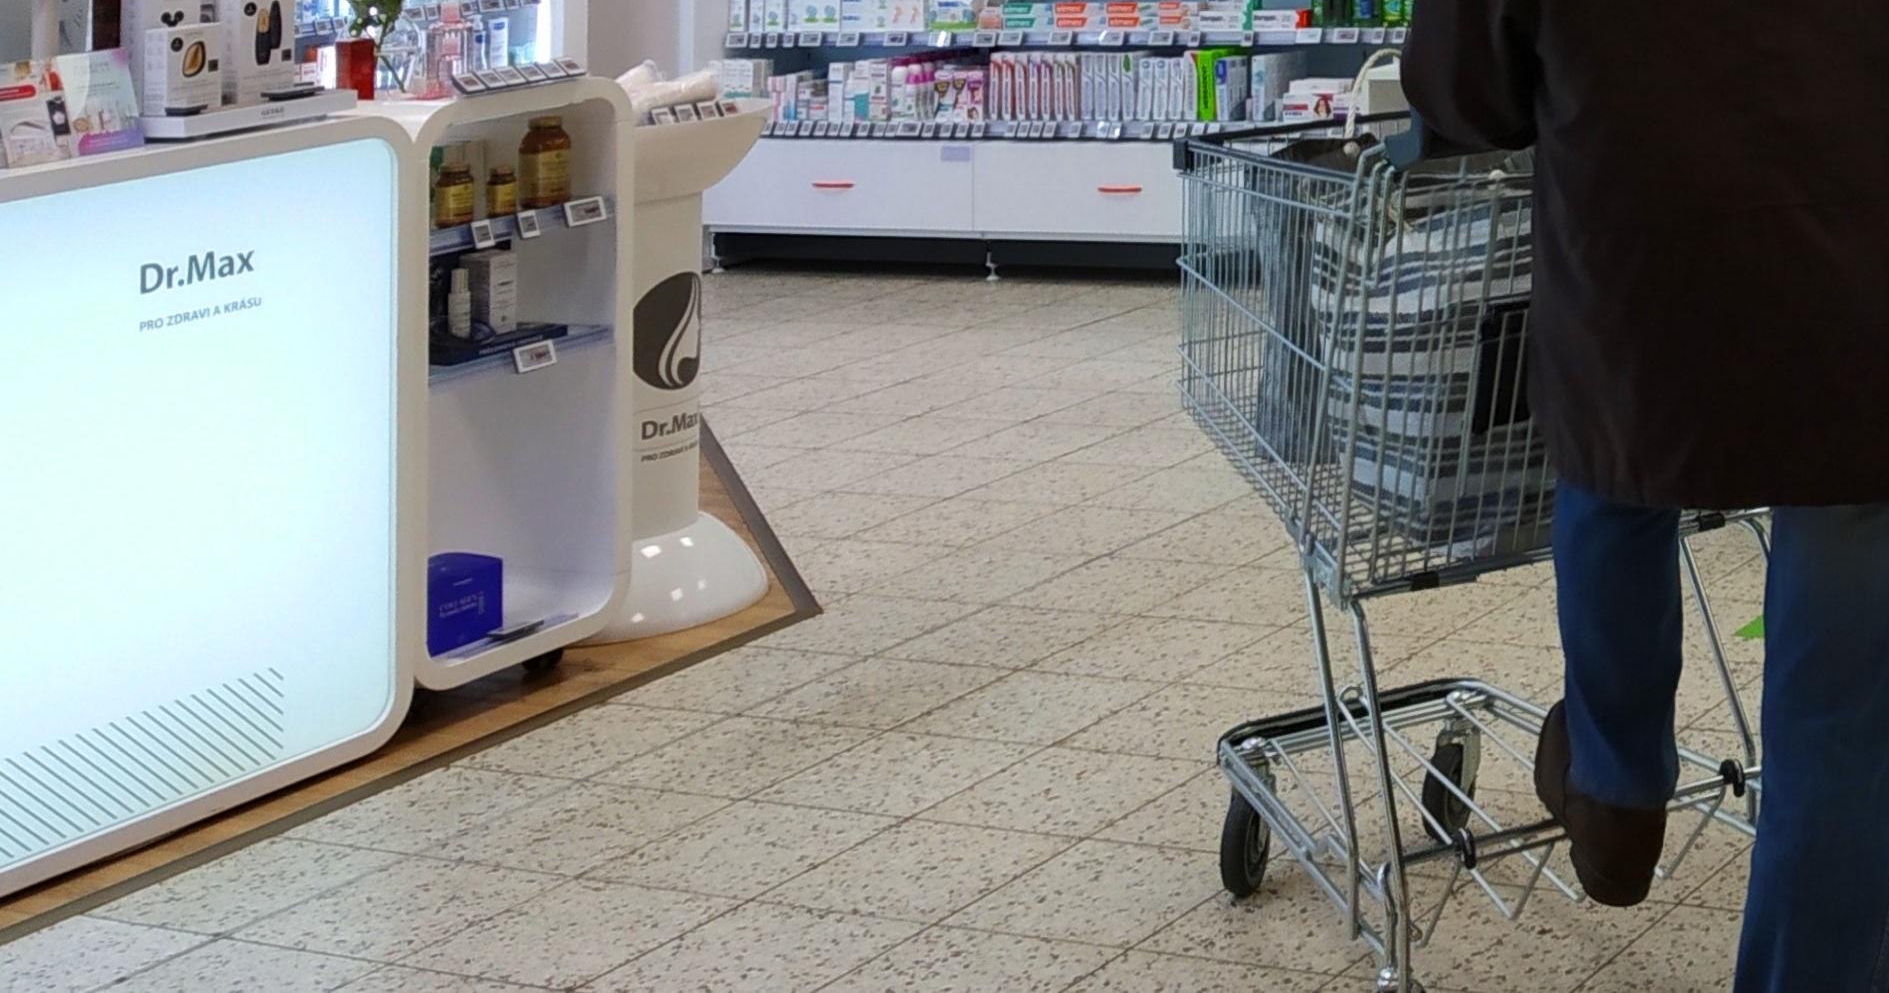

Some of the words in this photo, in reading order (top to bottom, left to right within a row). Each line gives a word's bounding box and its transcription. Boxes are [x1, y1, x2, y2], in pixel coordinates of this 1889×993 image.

[139, 250, 255, 294] Dr.Max
[139, 317, 164, 332] PRO
[212, 305, 221, 316] A
